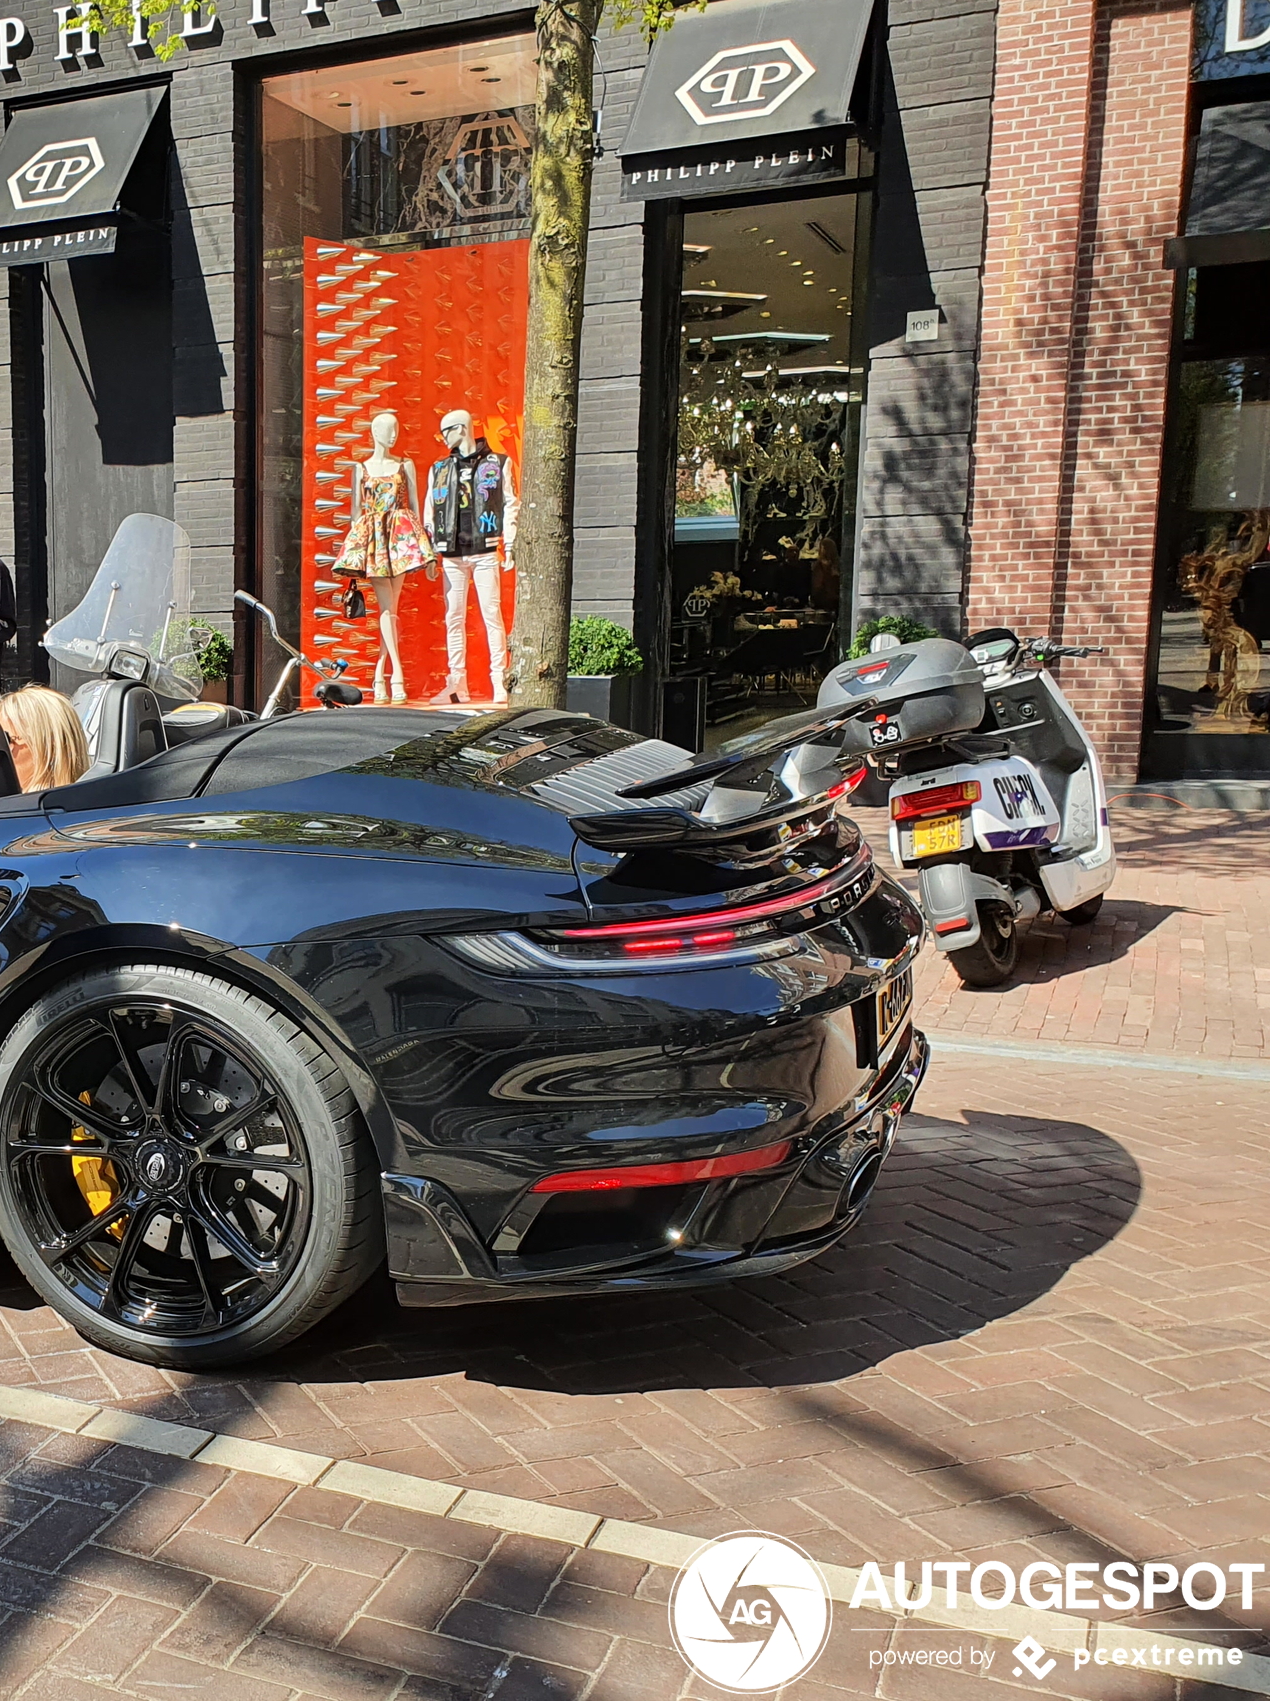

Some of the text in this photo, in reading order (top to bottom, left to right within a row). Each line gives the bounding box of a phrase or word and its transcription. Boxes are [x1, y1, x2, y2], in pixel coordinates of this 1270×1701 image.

[631, 145, 835, 185] PHILIPP PLEIN
[53, 228, 109, 247] PLEIN
[929, 834, 956, 850] 57R
